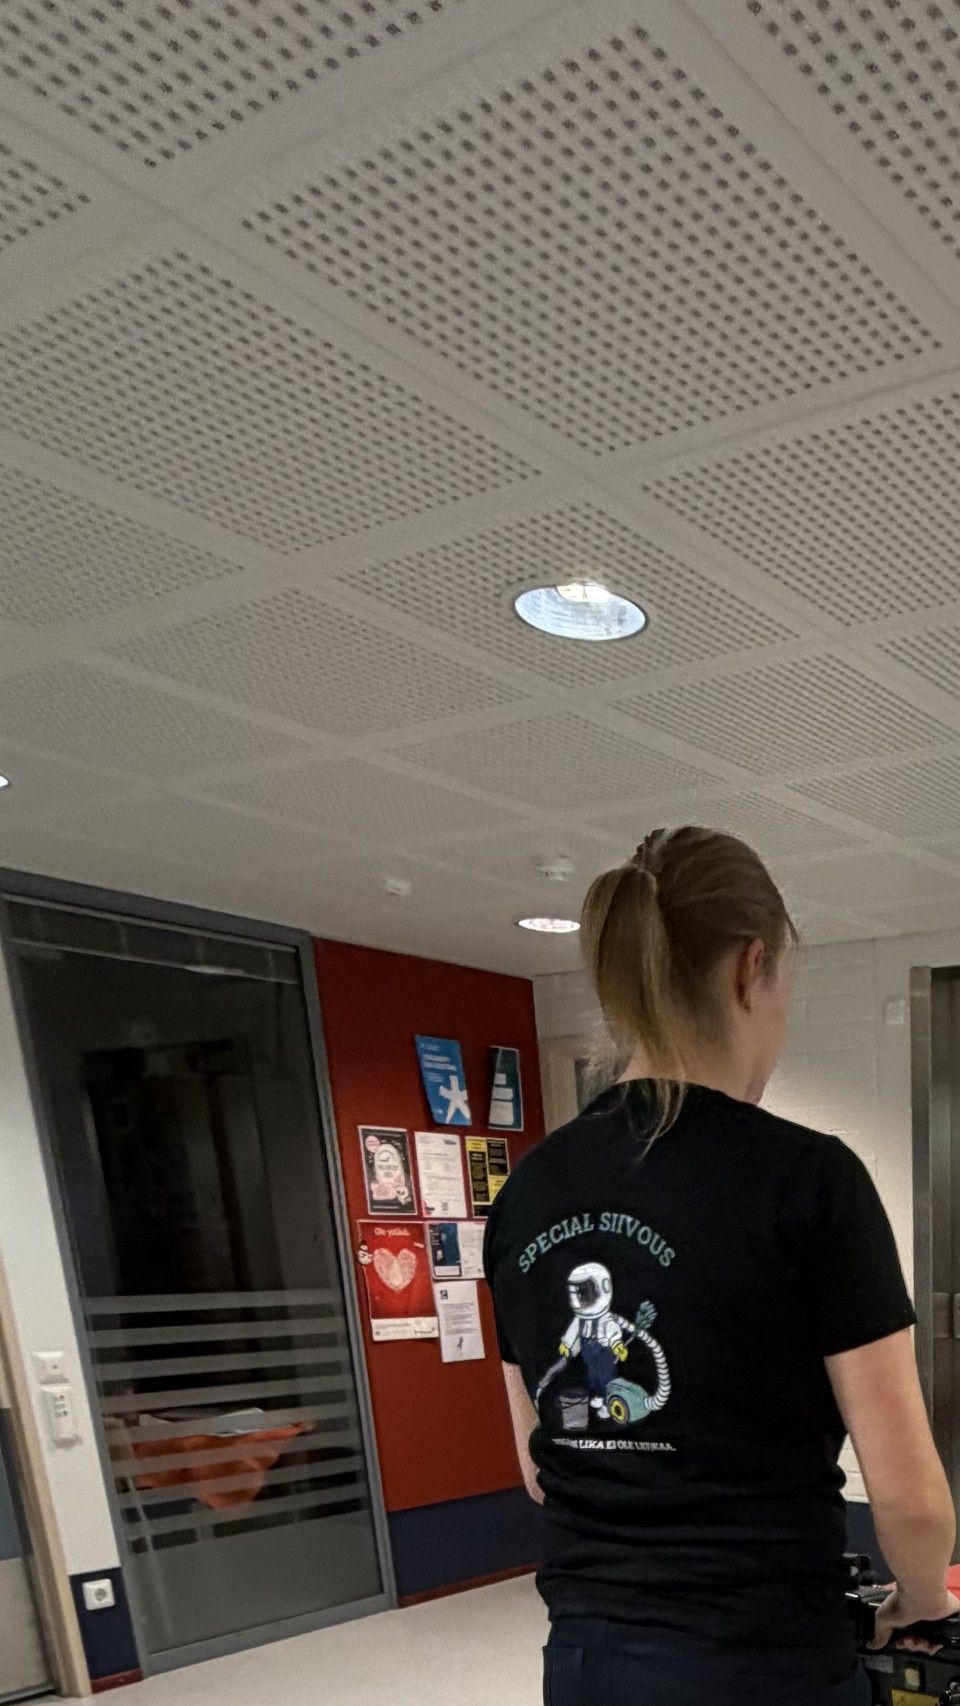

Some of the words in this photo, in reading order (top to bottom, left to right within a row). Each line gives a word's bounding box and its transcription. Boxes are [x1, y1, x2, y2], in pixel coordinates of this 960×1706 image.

[518, 1213, 595, 1273] SPECIAL
[599, 1212, 676, 1267] SIIVOUS
[580, 1440, 604, 1449] LIKA
